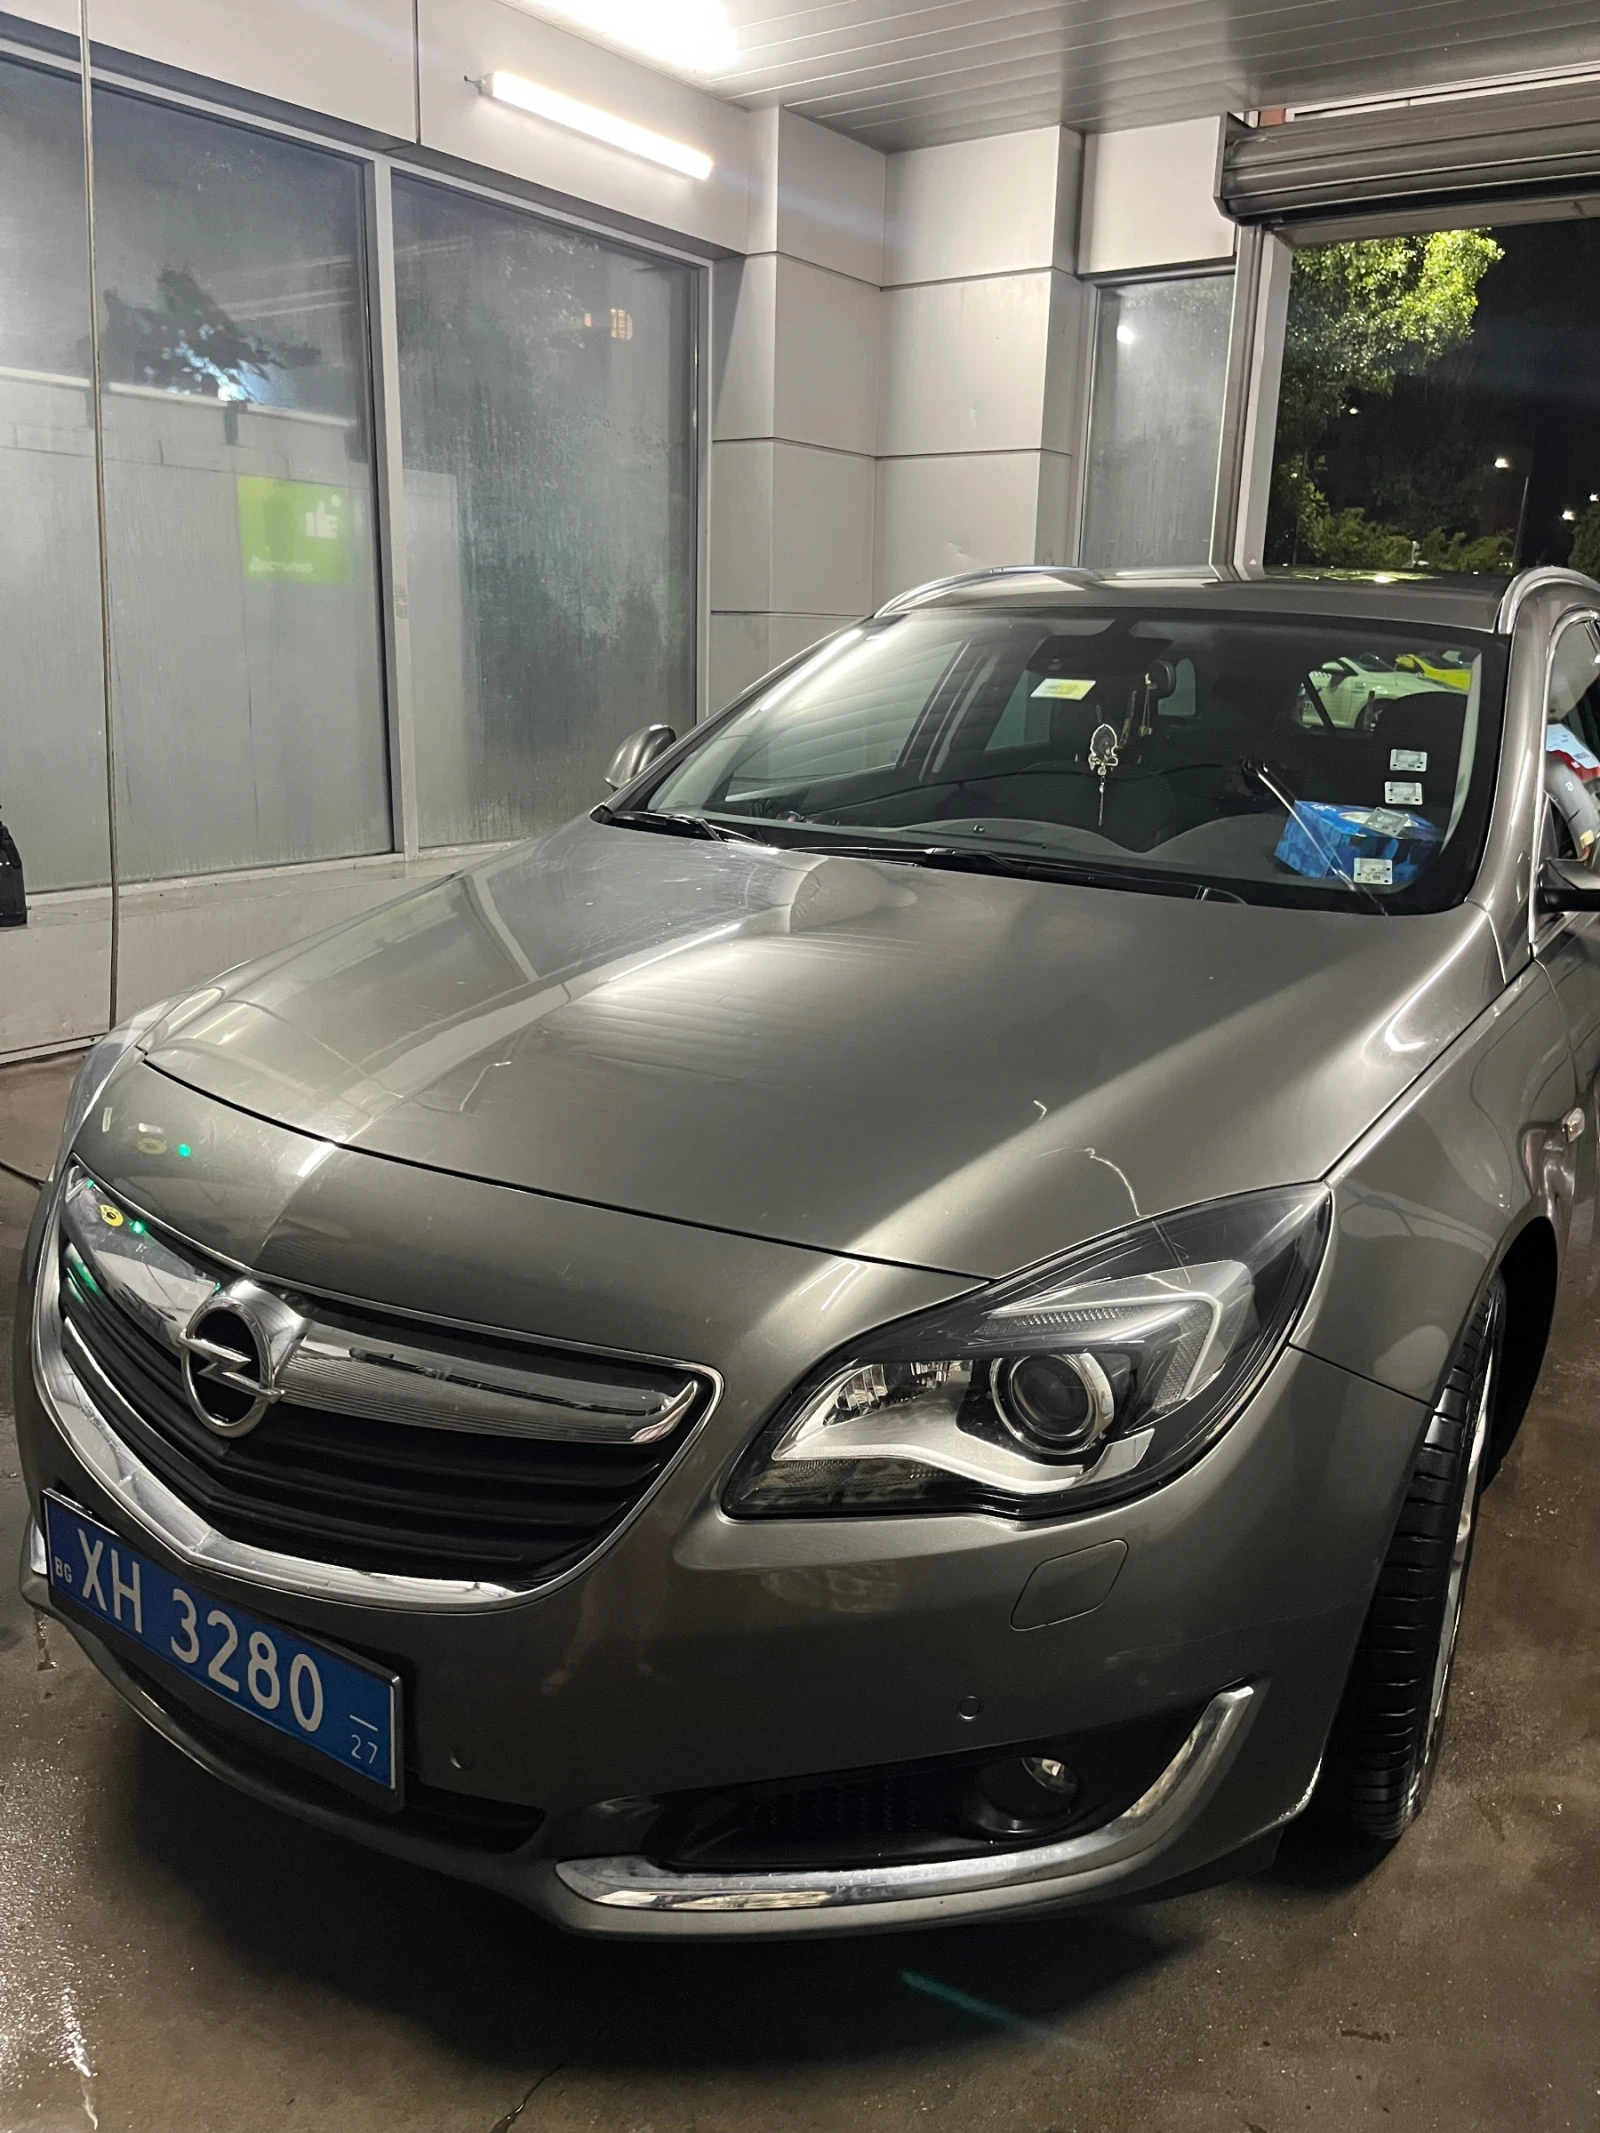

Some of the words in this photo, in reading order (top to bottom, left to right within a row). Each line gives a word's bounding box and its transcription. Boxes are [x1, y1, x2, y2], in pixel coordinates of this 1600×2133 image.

[54, 1557, 73, 1584] BG
[77, 1527, 143, 1634] XH
[170, 1588, 324, 1732] 3280
[351, 1734, 378, 1765] 27
